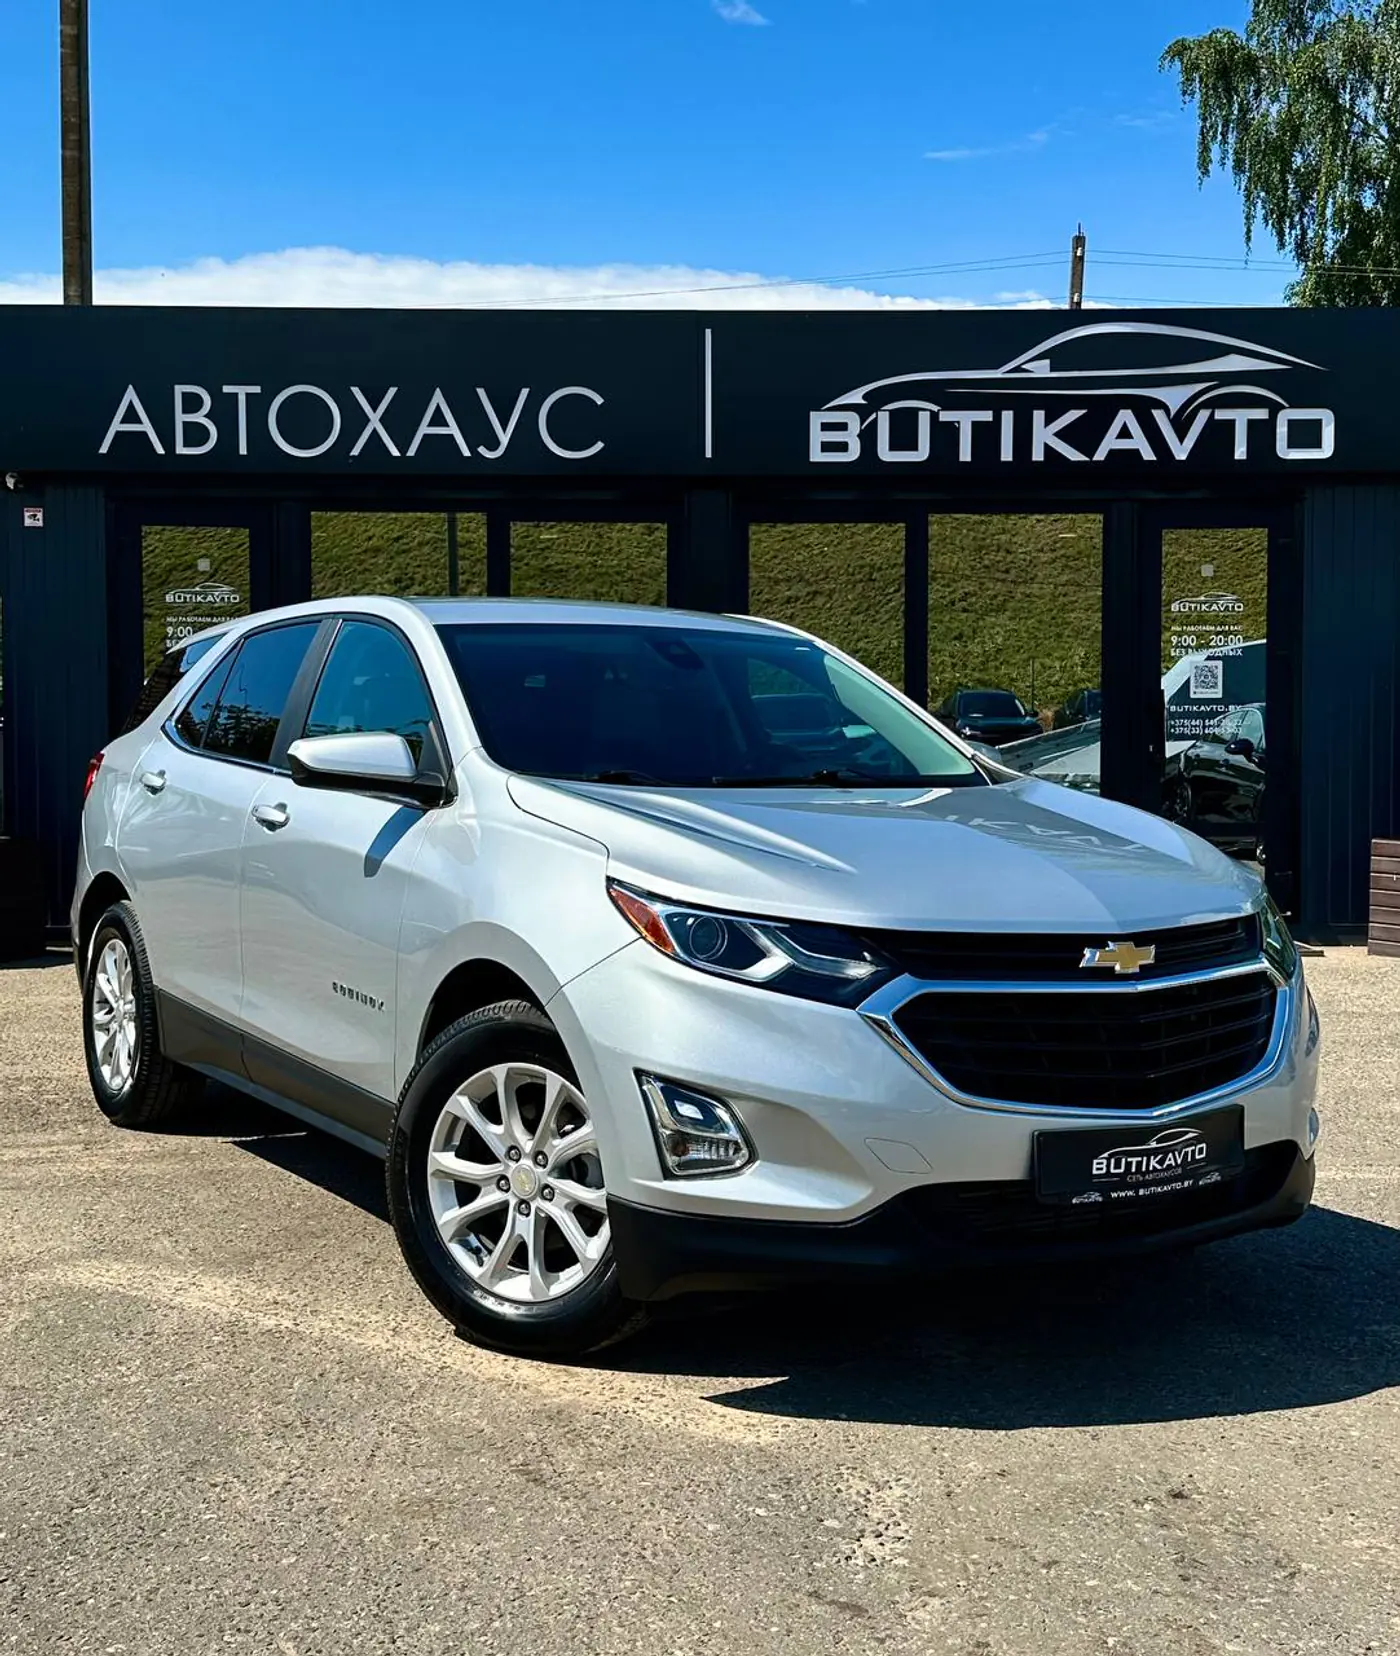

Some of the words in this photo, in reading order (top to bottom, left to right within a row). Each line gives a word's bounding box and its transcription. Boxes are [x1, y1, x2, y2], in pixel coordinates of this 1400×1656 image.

[98, 383, 605, 460] АВТОХАУС
[809, 407, 1335, 463] BUTIKAVTO
[165, 592, 240, 603] BUTIKAVTO
[1170, 602, 1244, 612] BUTIKAVTO
[1170, 635, 1197, 646] 9:00
[1208, 635, 1243, 646] 20:00
[1170, 648, 1186, 657] БЕЗ
[1091, 1142, 1207, 1175] BUTIKAVTO
[1138, 1179, 1194, 1196] BUTIKAVTO.BY
